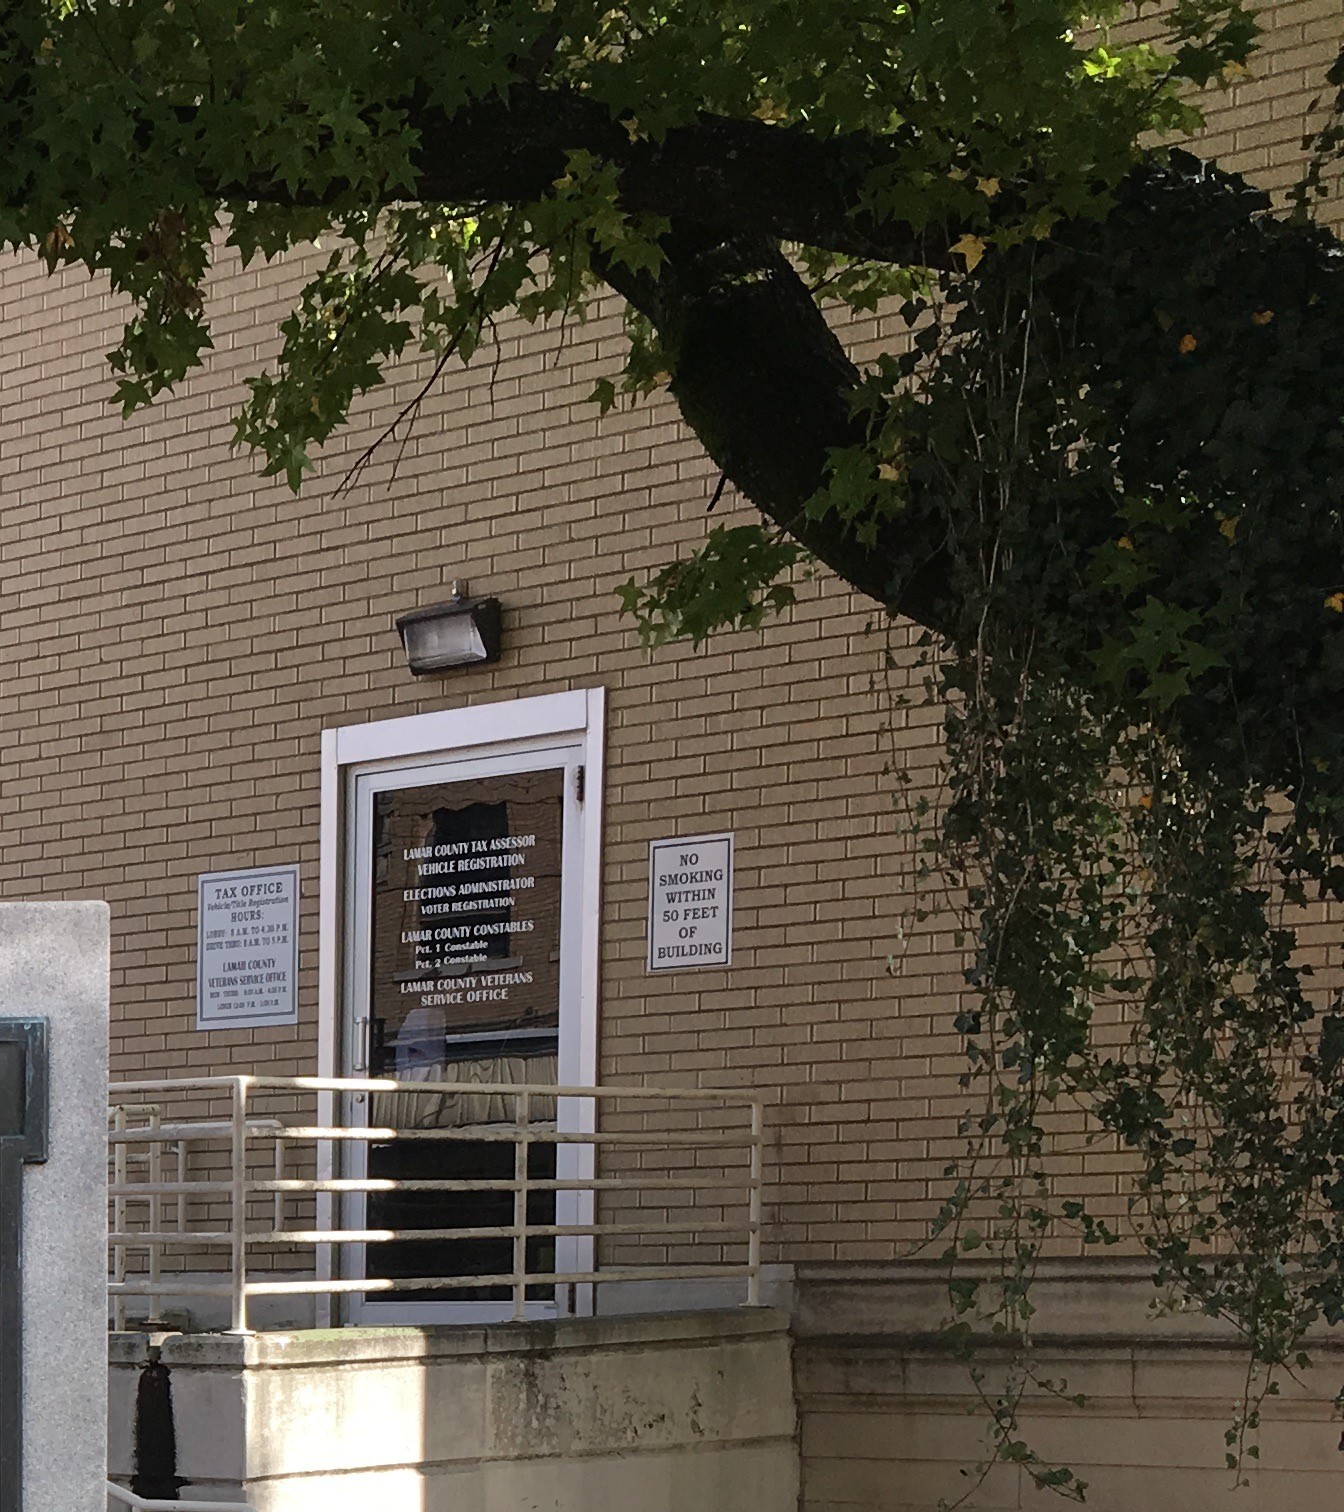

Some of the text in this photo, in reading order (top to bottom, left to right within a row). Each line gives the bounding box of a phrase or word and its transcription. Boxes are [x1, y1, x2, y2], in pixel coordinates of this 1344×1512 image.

[404, 835, 535, 860] LAMAR COUNTY TAX ASSESSOR
[418, 853, 525, 876] VEHICLE REGISTRATION
[680, 853, 698, 866] NO
[660, 869, 723, 886] SMOKING
[215, 882, 283, 900] TAX OFFICE
[404, 877, 534, 901] ELECTIONS ADMINISTRATOR
[666, 888, 716, 903] WITHIN
[249, 897, 288, 908] Registration
[421, 897, 515, 915] VOTER REGISTRATION
[231, 910, 264, 922] HOURS:
[663, 906, 718, 922] 50 FEET
[402, 920, 534, 943] LAMAR COUNTY CONSTABLES
[679, 926, 697, 938] OF
[416, 940, 488, 954] Pct. 1 Constable
[658, 942, 722, 959] BUILDING
[248, 958, 276, 970] COUNTY
[416, 954, 487, 969] Pct. 2 Constable
[266, 972, 286, 983] OFFICE
[401, 972, 533, 994] LAMAR COUNTY VETERANS
[421, 988, 508, 1006] SERVICE OFFICE
